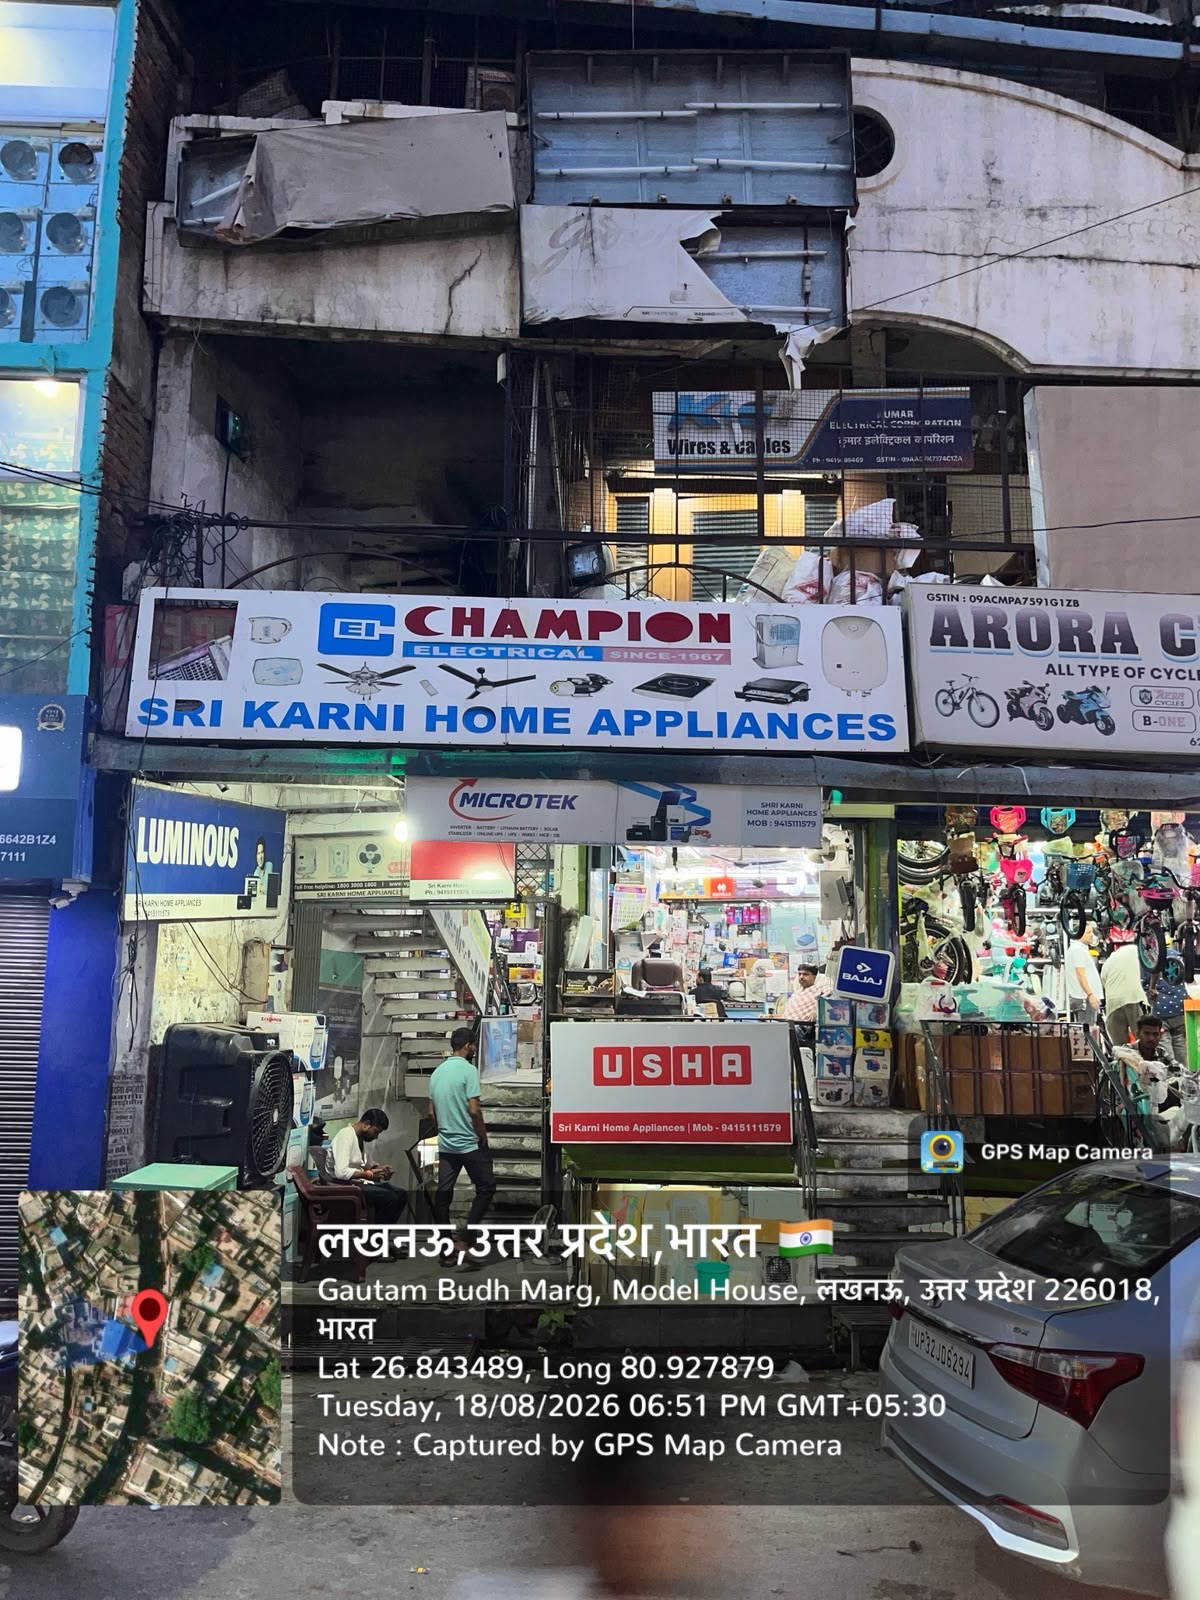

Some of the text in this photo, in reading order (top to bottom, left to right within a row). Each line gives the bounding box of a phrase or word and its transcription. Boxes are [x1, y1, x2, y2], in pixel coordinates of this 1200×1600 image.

[877, 410, 914, 419] UMAR
[668, 439, 791, 455] Wires & Cales
[926, 593, 959, 603] GSTIN
[969, 594, 1080, 608] 09ACMPA7591G1ZB
[404, 605, 731, 644] CHAMPION
[929, 605, 1200, 659] ARORA C
[413, 644, 724, 664] ELECTRICAL SINCE-1967
[1045, 662, 1074, 678] ALL
[1077, 664, 1120, 679] TYPE
[1124, 666, 1146, 680] OF
[137, 698, 897, 742] SRI KARNI HOME APPLIANCES
[1143, 715, 1186, 728] B-ONE
[459, 792, 579, 810] MICROTEK
[773, 820, 816, 828] 9415111579
[0, 833, 57, 845] 6642B1Z4
[137, 816, 239, 869] LUMINOUS
[0, 851, 26, 862] 7111
[842, 972, 883, 986] BAJAJ
[601, 1052, 743, 1079] USHA
[558, 1123, 572, 1132] Sri
[574, 1123, 600, 1132] Karni
[602, 1123, 630, 1132] Home
[633, 1123, 685, 1133] Appliances
[692, 1123, 713, 1132] Mob
[721, 1123, 782, 1132] 9415111579
[914, 1327, 970, 1380] UP32JD6294
